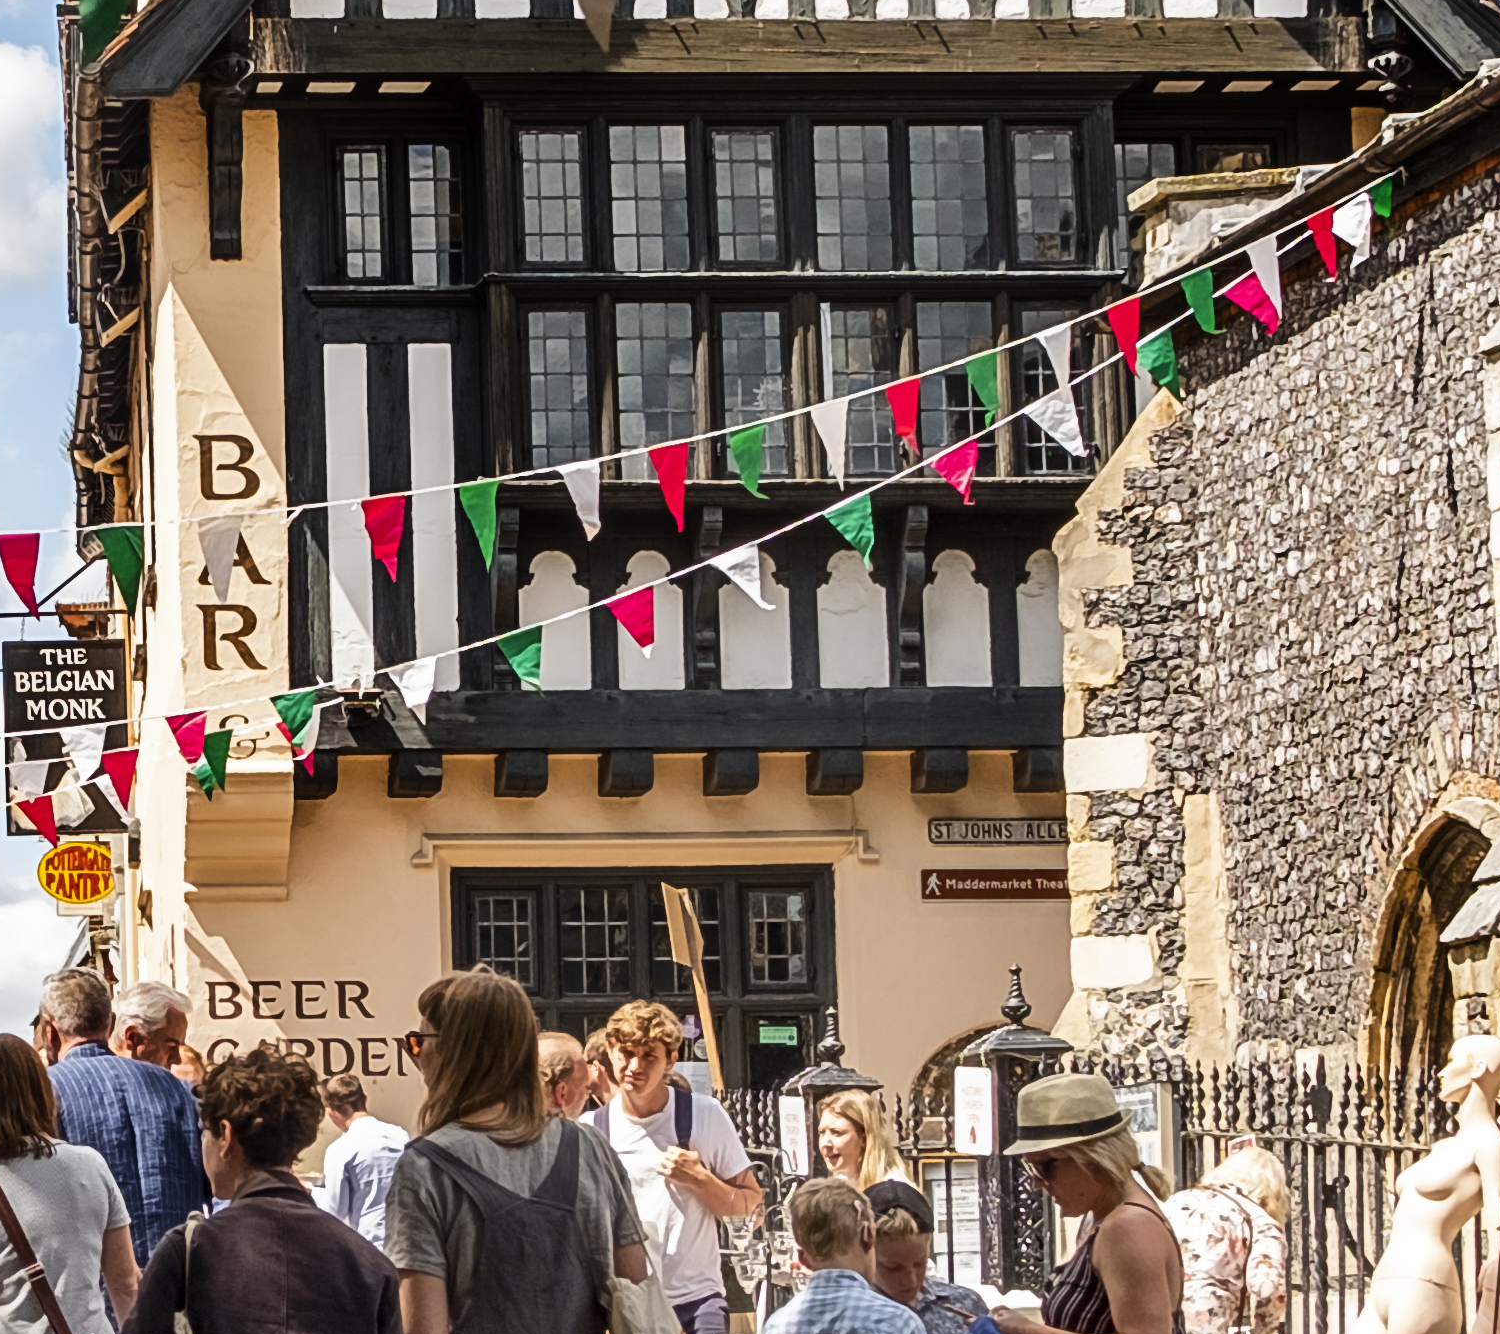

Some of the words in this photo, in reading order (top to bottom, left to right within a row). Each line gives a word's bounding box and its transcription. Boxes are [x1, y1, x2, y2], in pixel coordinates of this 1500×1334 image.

[39, 648, 88, 665] THE
[13, 670, 115, 693] BELGIAN
[25, 698, 106, 721] MONK
[933, 823, 953, 839] ST
[960, 823, 1013, 839] JOHNS
[1025, 823, 1068, 839] ALLE
[45, 871, 114, 902] PANTRY
[945, 878, 1032, 890] Maddermarket
[1035, 878, 1069, 890] Theat
[205, 980, 376, 1020] BEER
